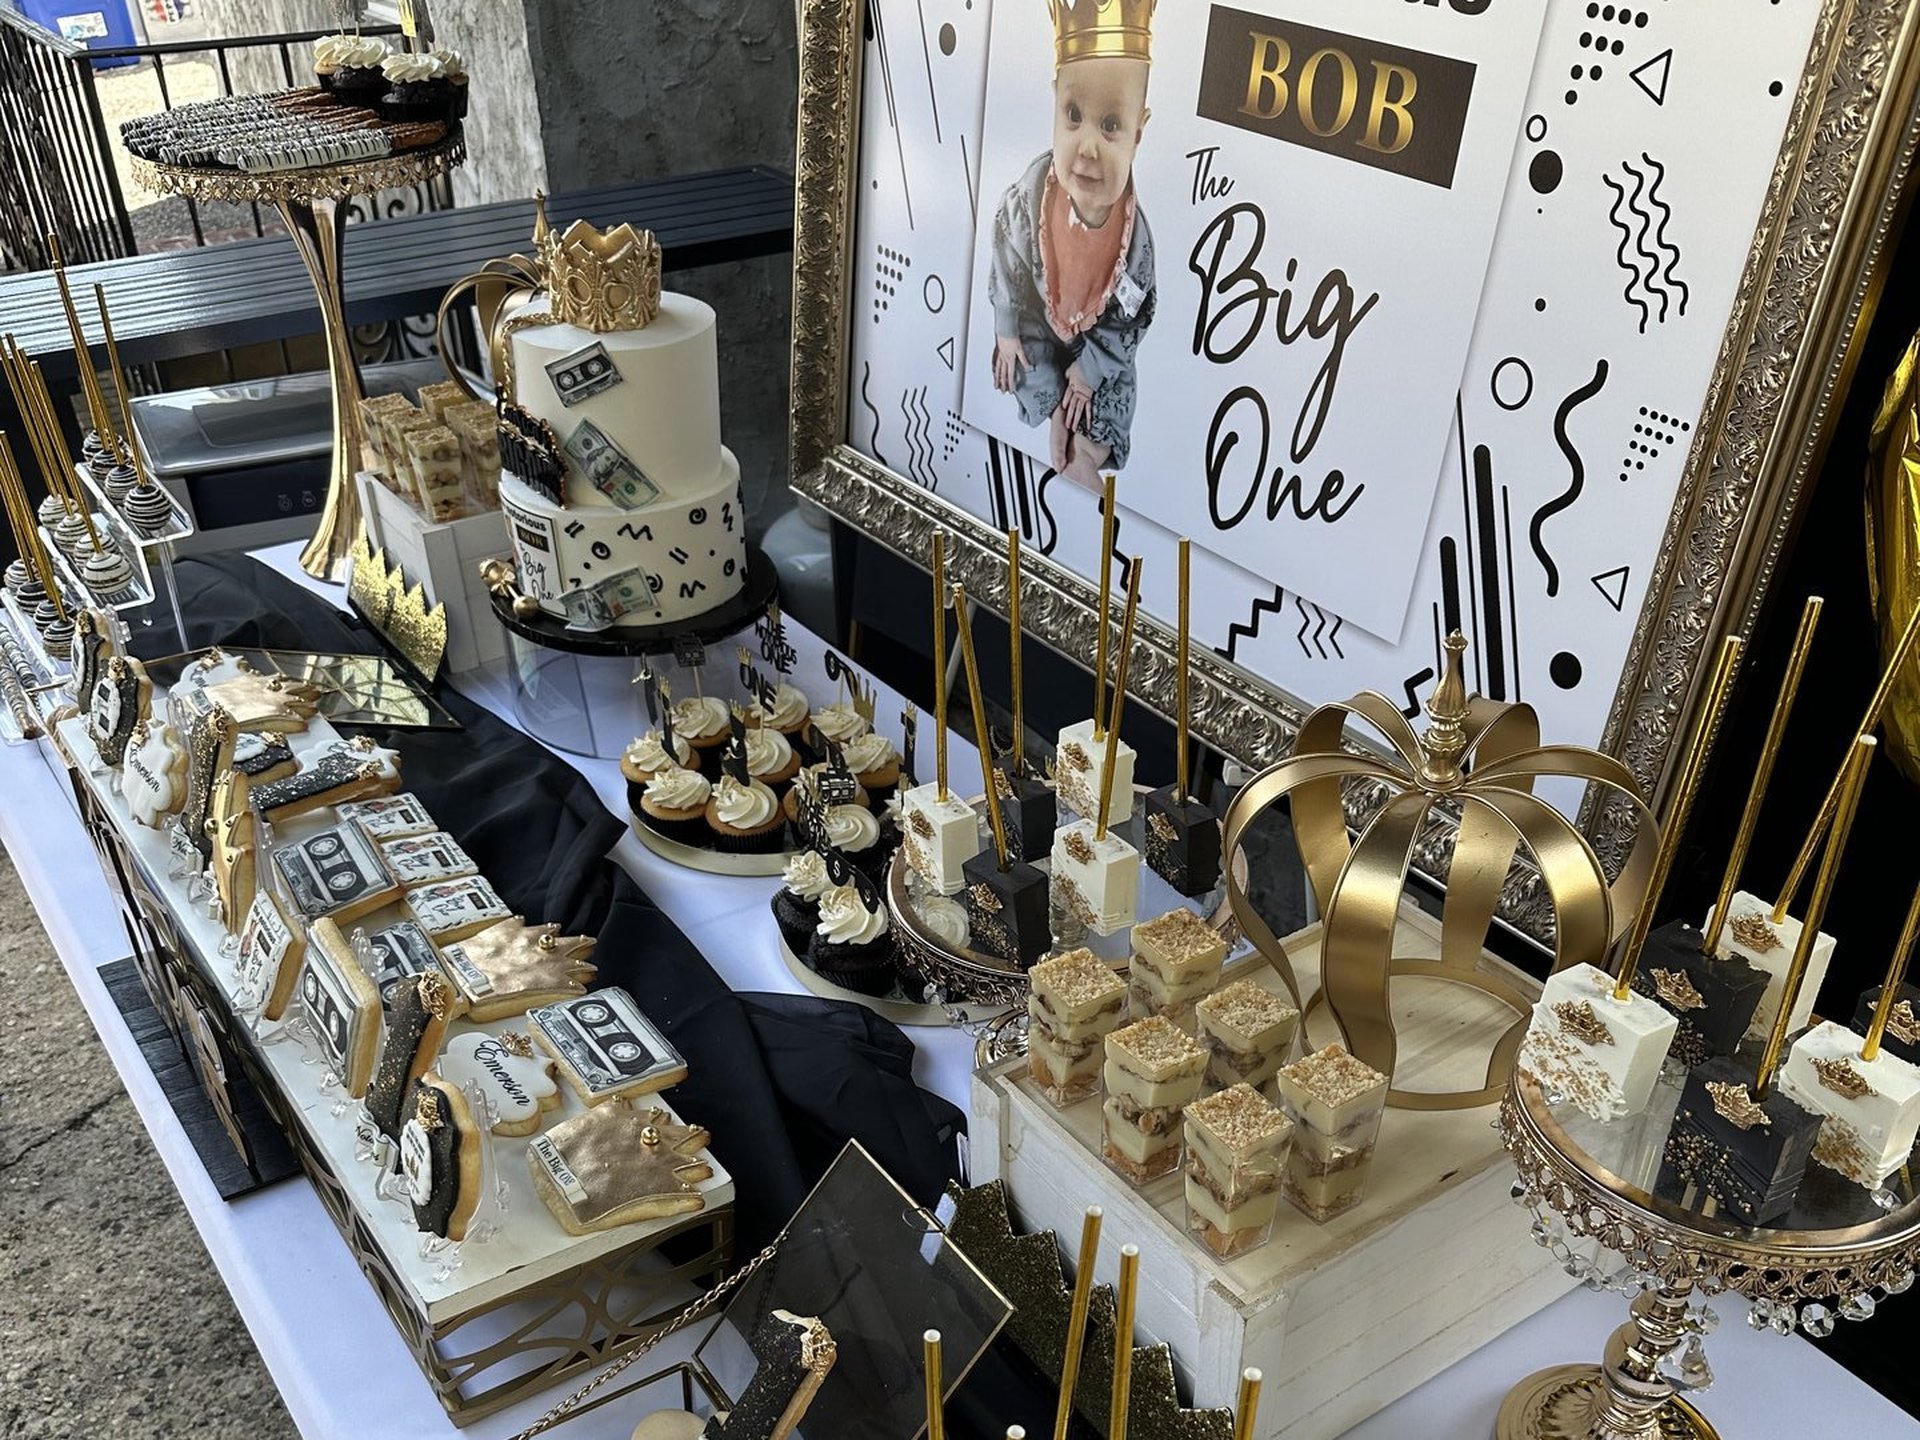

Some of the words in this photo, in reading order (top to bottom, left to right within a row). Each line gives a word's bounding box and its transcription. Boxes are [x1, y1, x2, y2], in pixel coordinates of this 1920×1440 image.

[1237, 31, 1418, 154] BOB
[1186, 146, 1235, 205] The
[1188, 202, 1379, 464] Big
[1205, 386, 1365, 530] One
[740, 662, 777, 715] ONE
[474, 1040, 530, 1106] Emerson
[537, 1139, 553, 1159] The
[548, 1156, 565, 1176] Big
